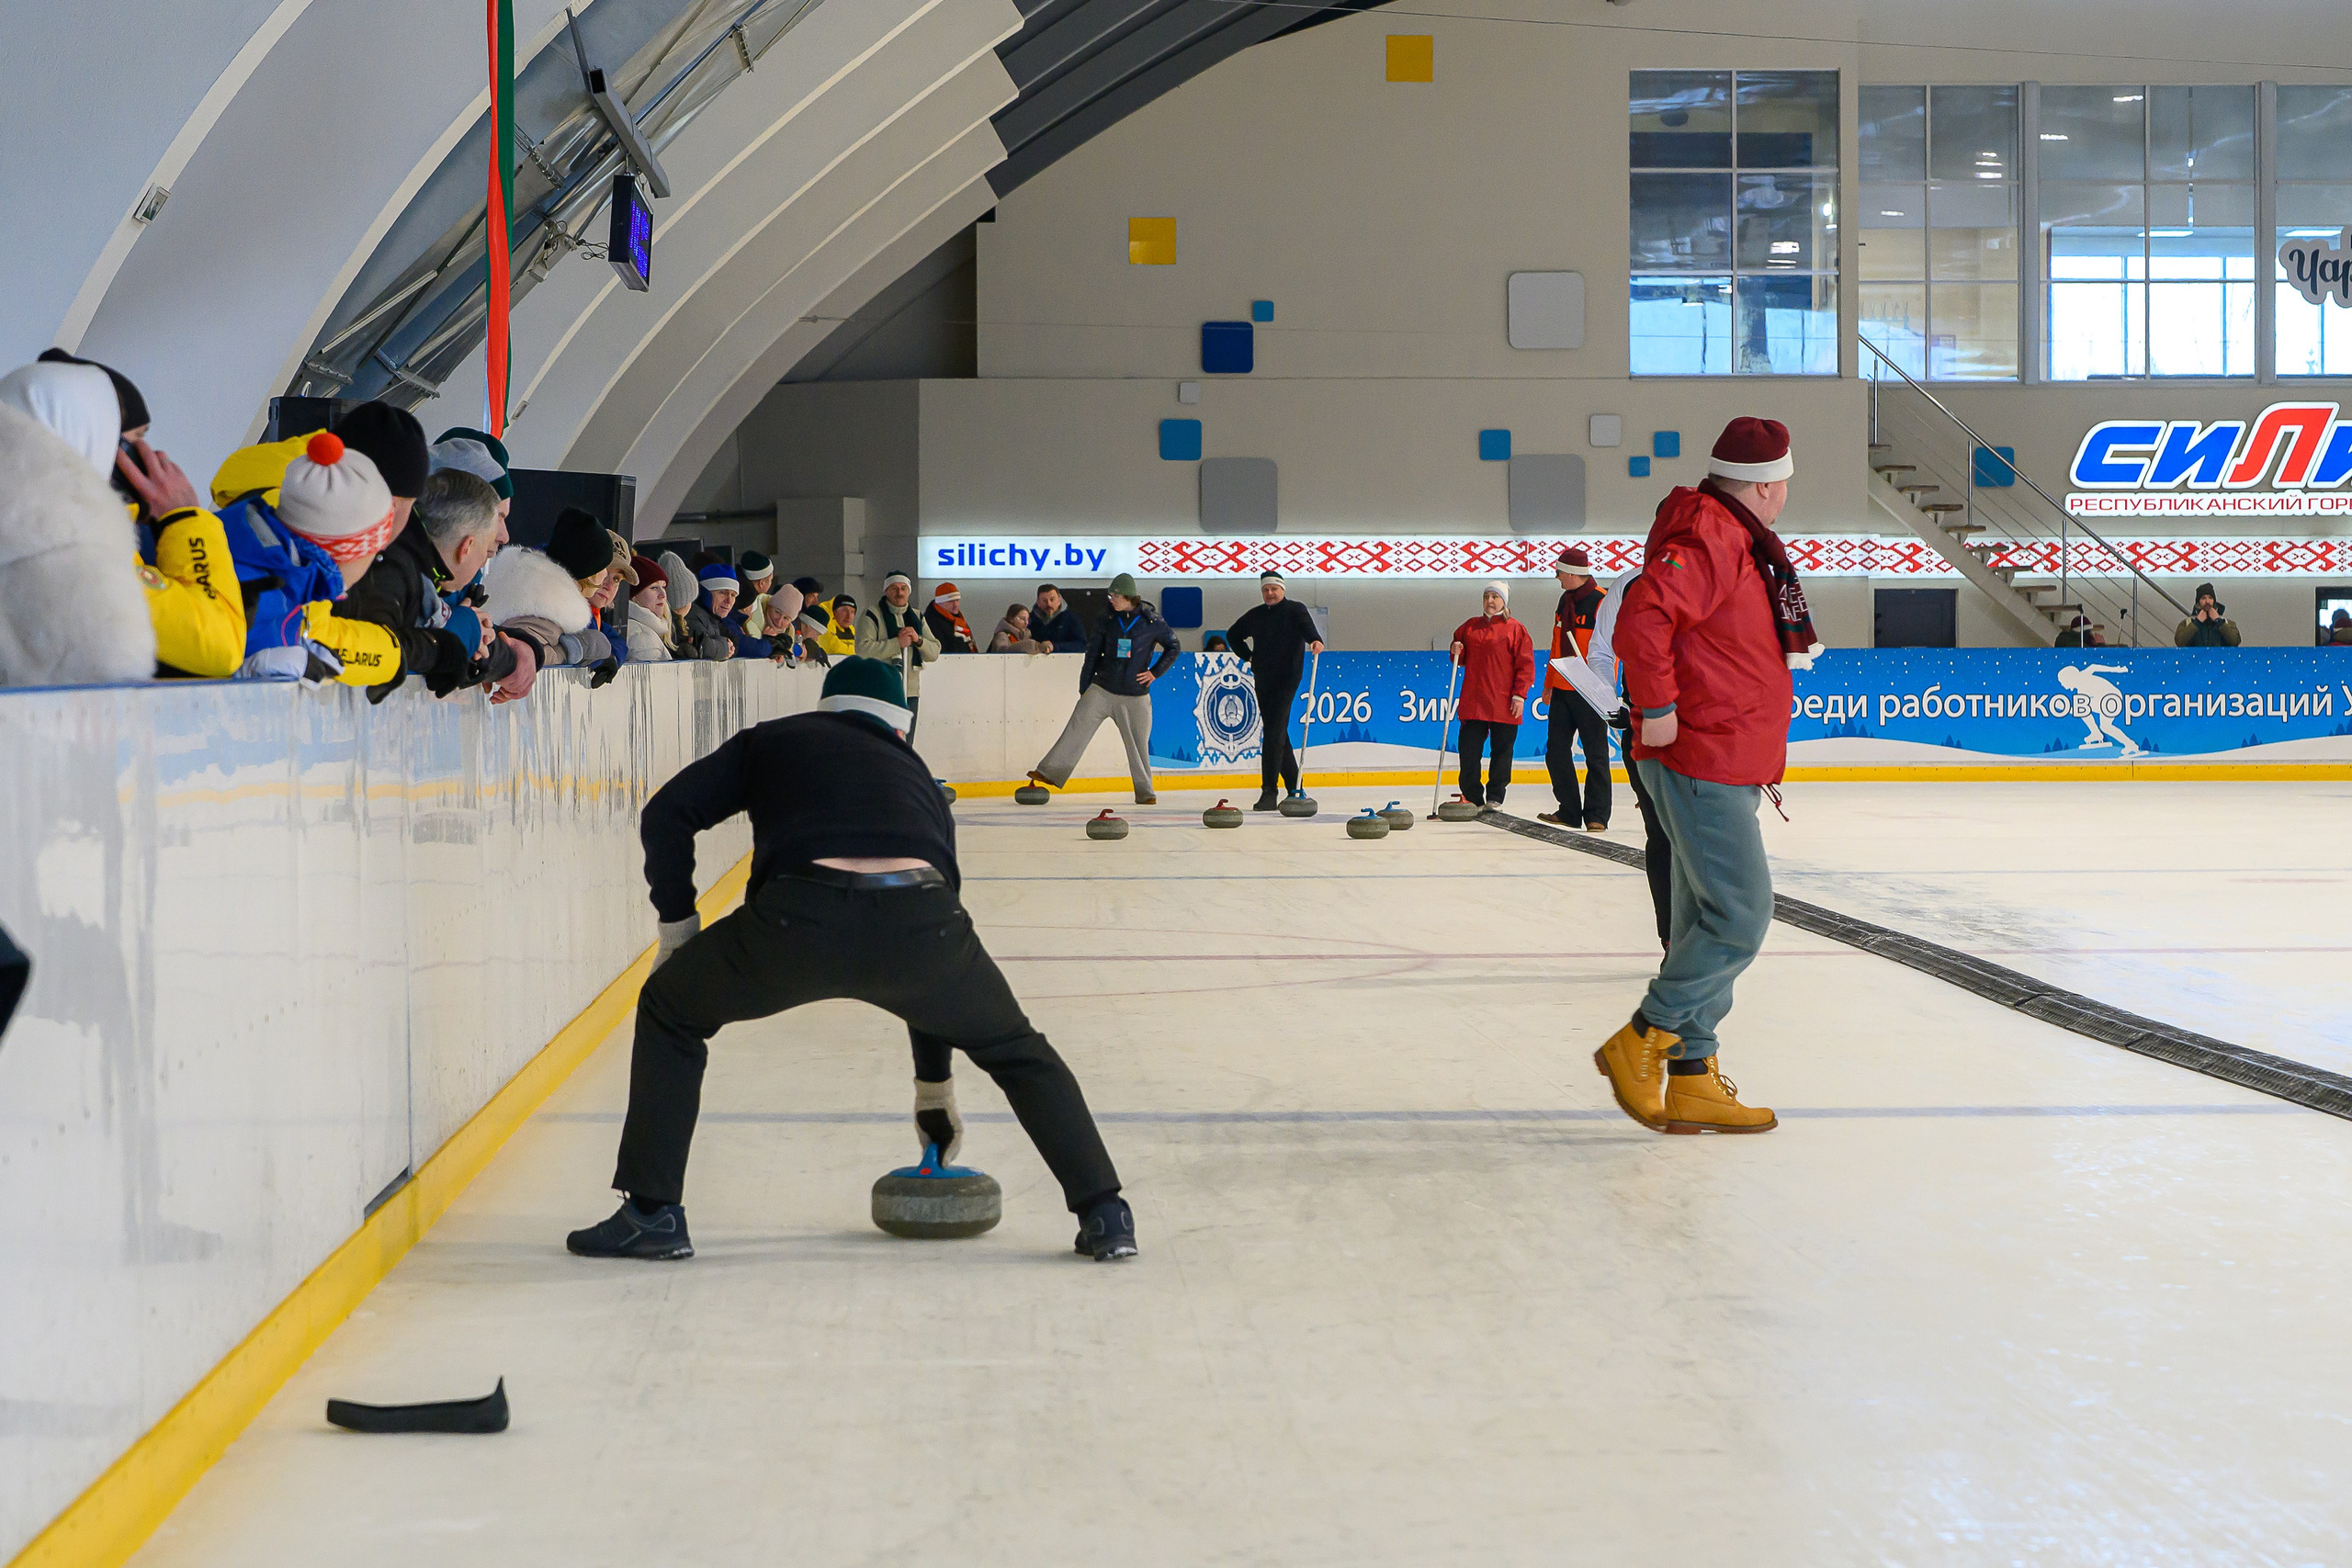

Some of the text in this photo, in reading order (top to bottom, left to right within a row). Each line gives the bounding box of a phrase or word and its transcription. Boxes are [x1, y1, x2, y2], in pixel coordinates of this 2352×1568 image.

[2069, 494, 2352, 511] РЕСПУБЛИКАНСКИЙ ГОР
[937, 543, 1107, 571] silichy.by
[1299, 691, 1373, 724] 2026
[1878, 683, 2092, 727] работников
[2099, 684, 2333, 725] организаций
